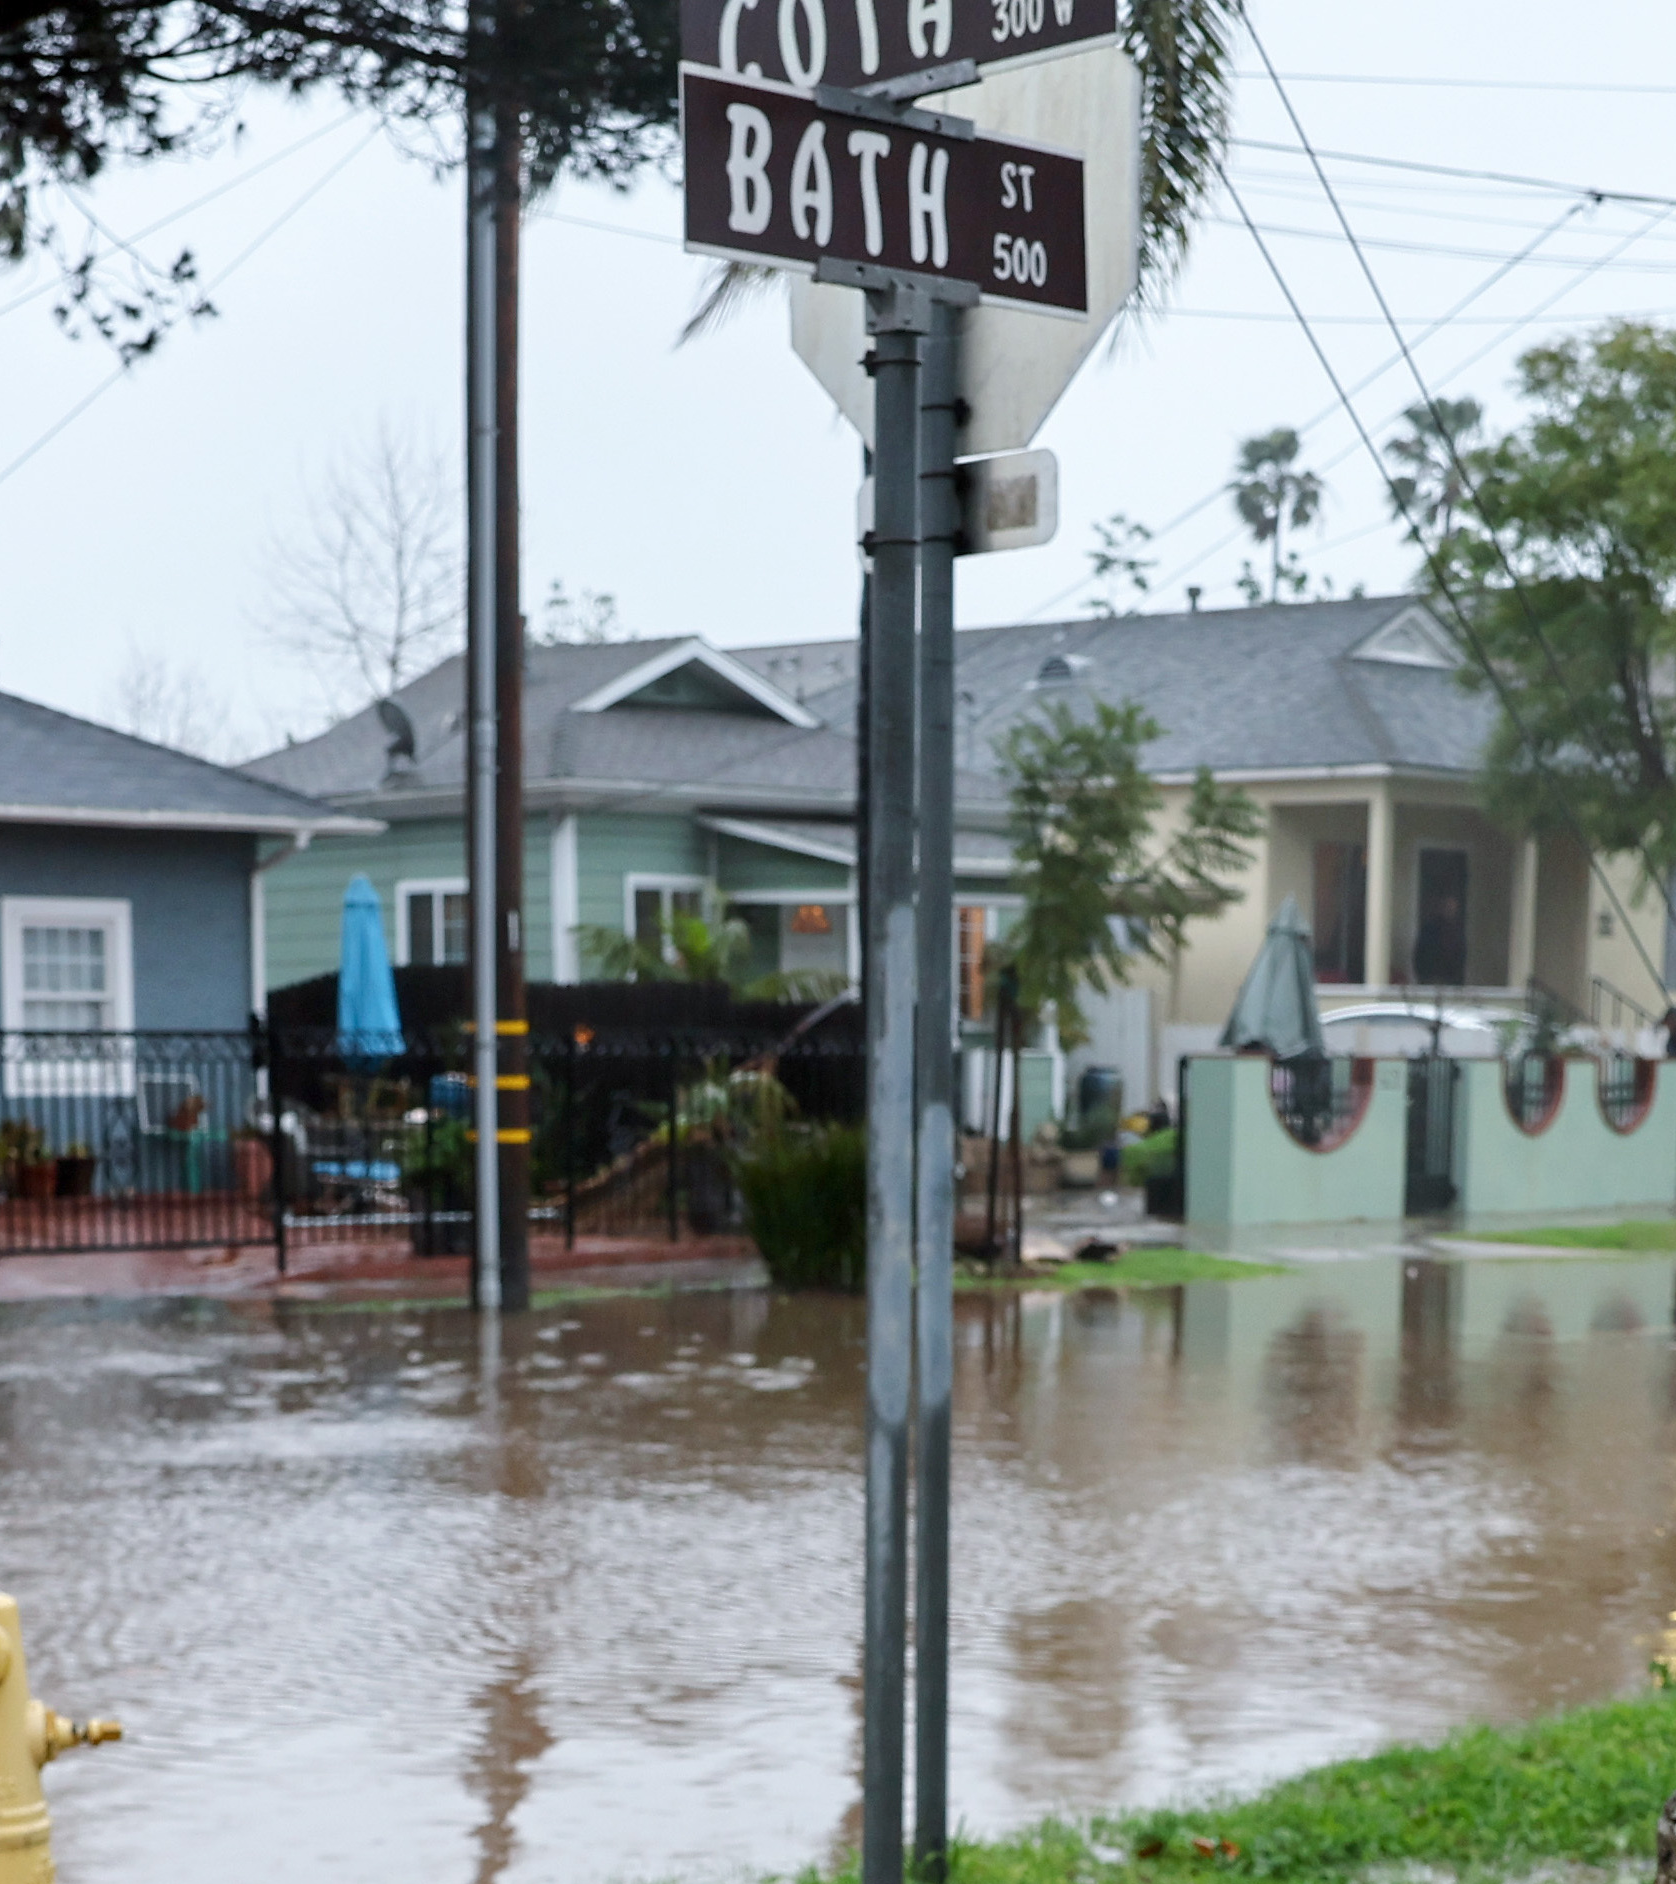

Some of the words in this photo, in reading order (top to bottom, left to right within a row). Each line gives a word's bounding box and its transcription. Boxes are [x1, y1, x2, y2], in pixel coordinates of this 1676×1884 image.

[991, 0, 1045, 42] 300
[1053, 0, 1074, 27] W
[726, 101, 950, 270] BATH
[1000, 161, 1036, 213] ST
[993, 232, 1047, 287] 500
